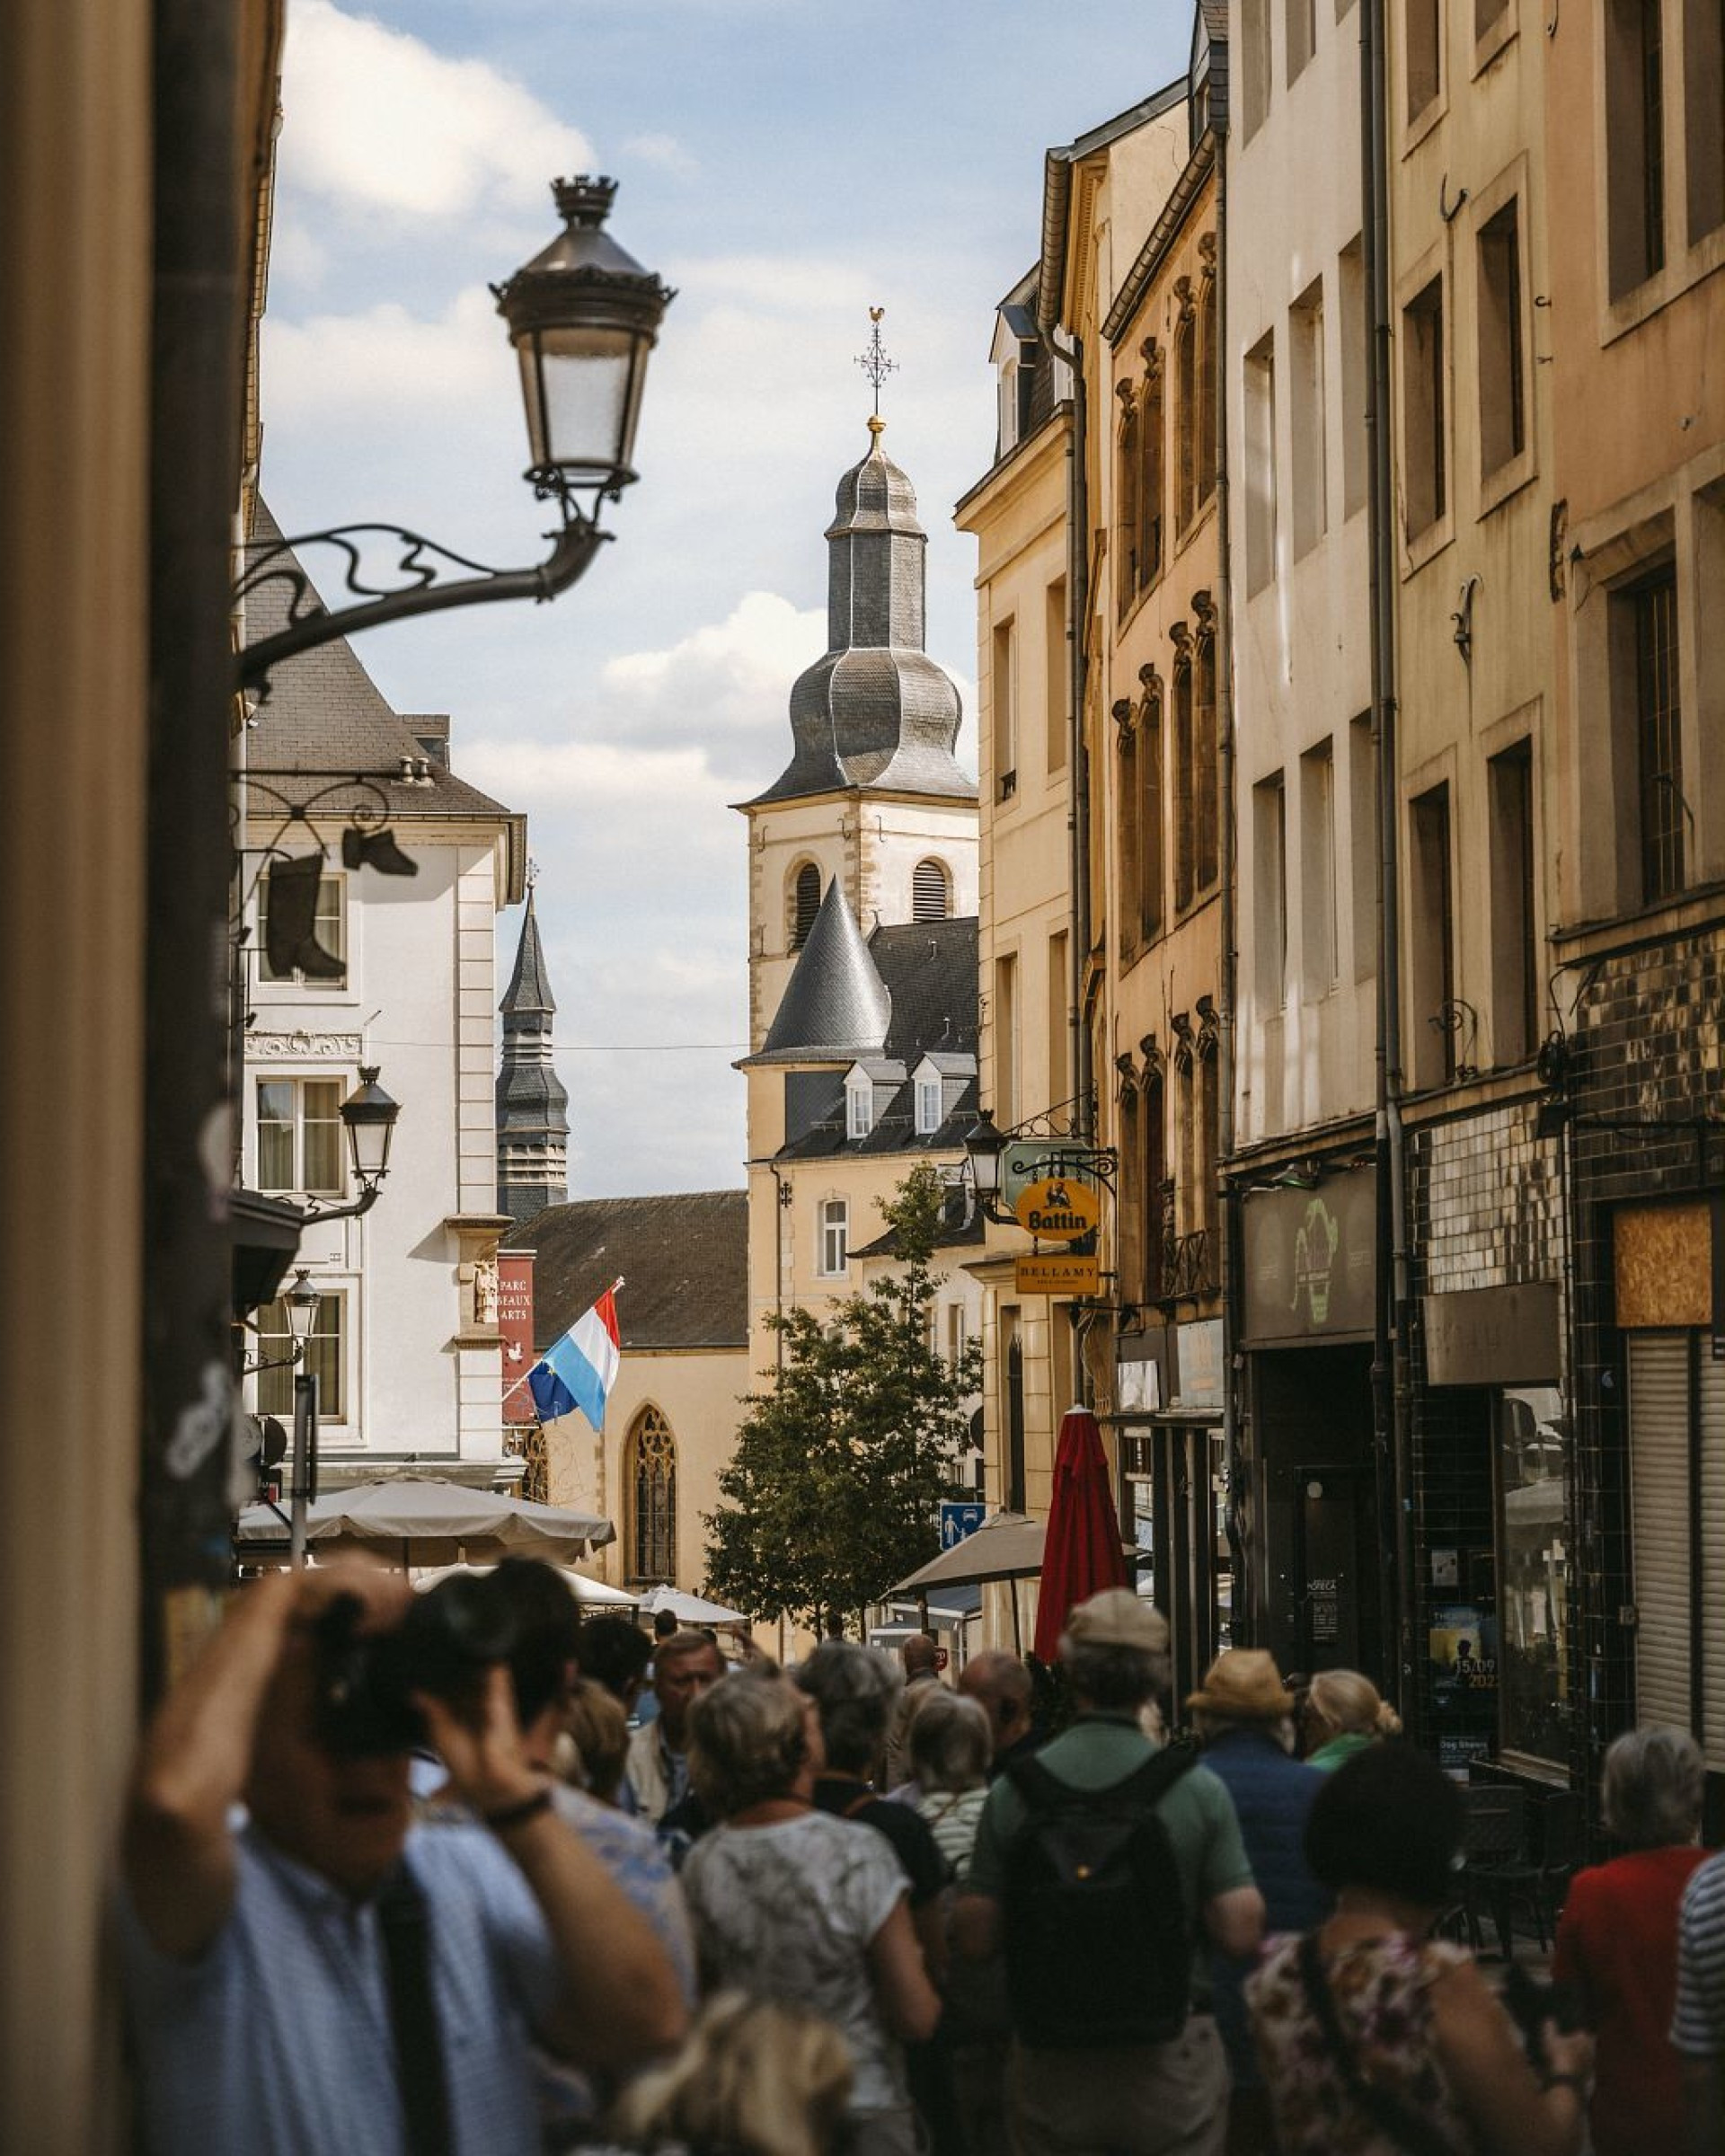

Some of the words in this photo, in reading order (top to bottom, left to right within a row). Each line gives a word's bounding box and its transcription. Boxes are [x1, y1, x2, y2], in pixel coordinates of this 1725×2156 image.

[1029, 1210, 1087, 1230] Battin
[1020, 1267, 1094, 1277] BELLAMY
[500, 1280, 526, 1291] PARC
[500, 1310, 526, 1320] ARTS
